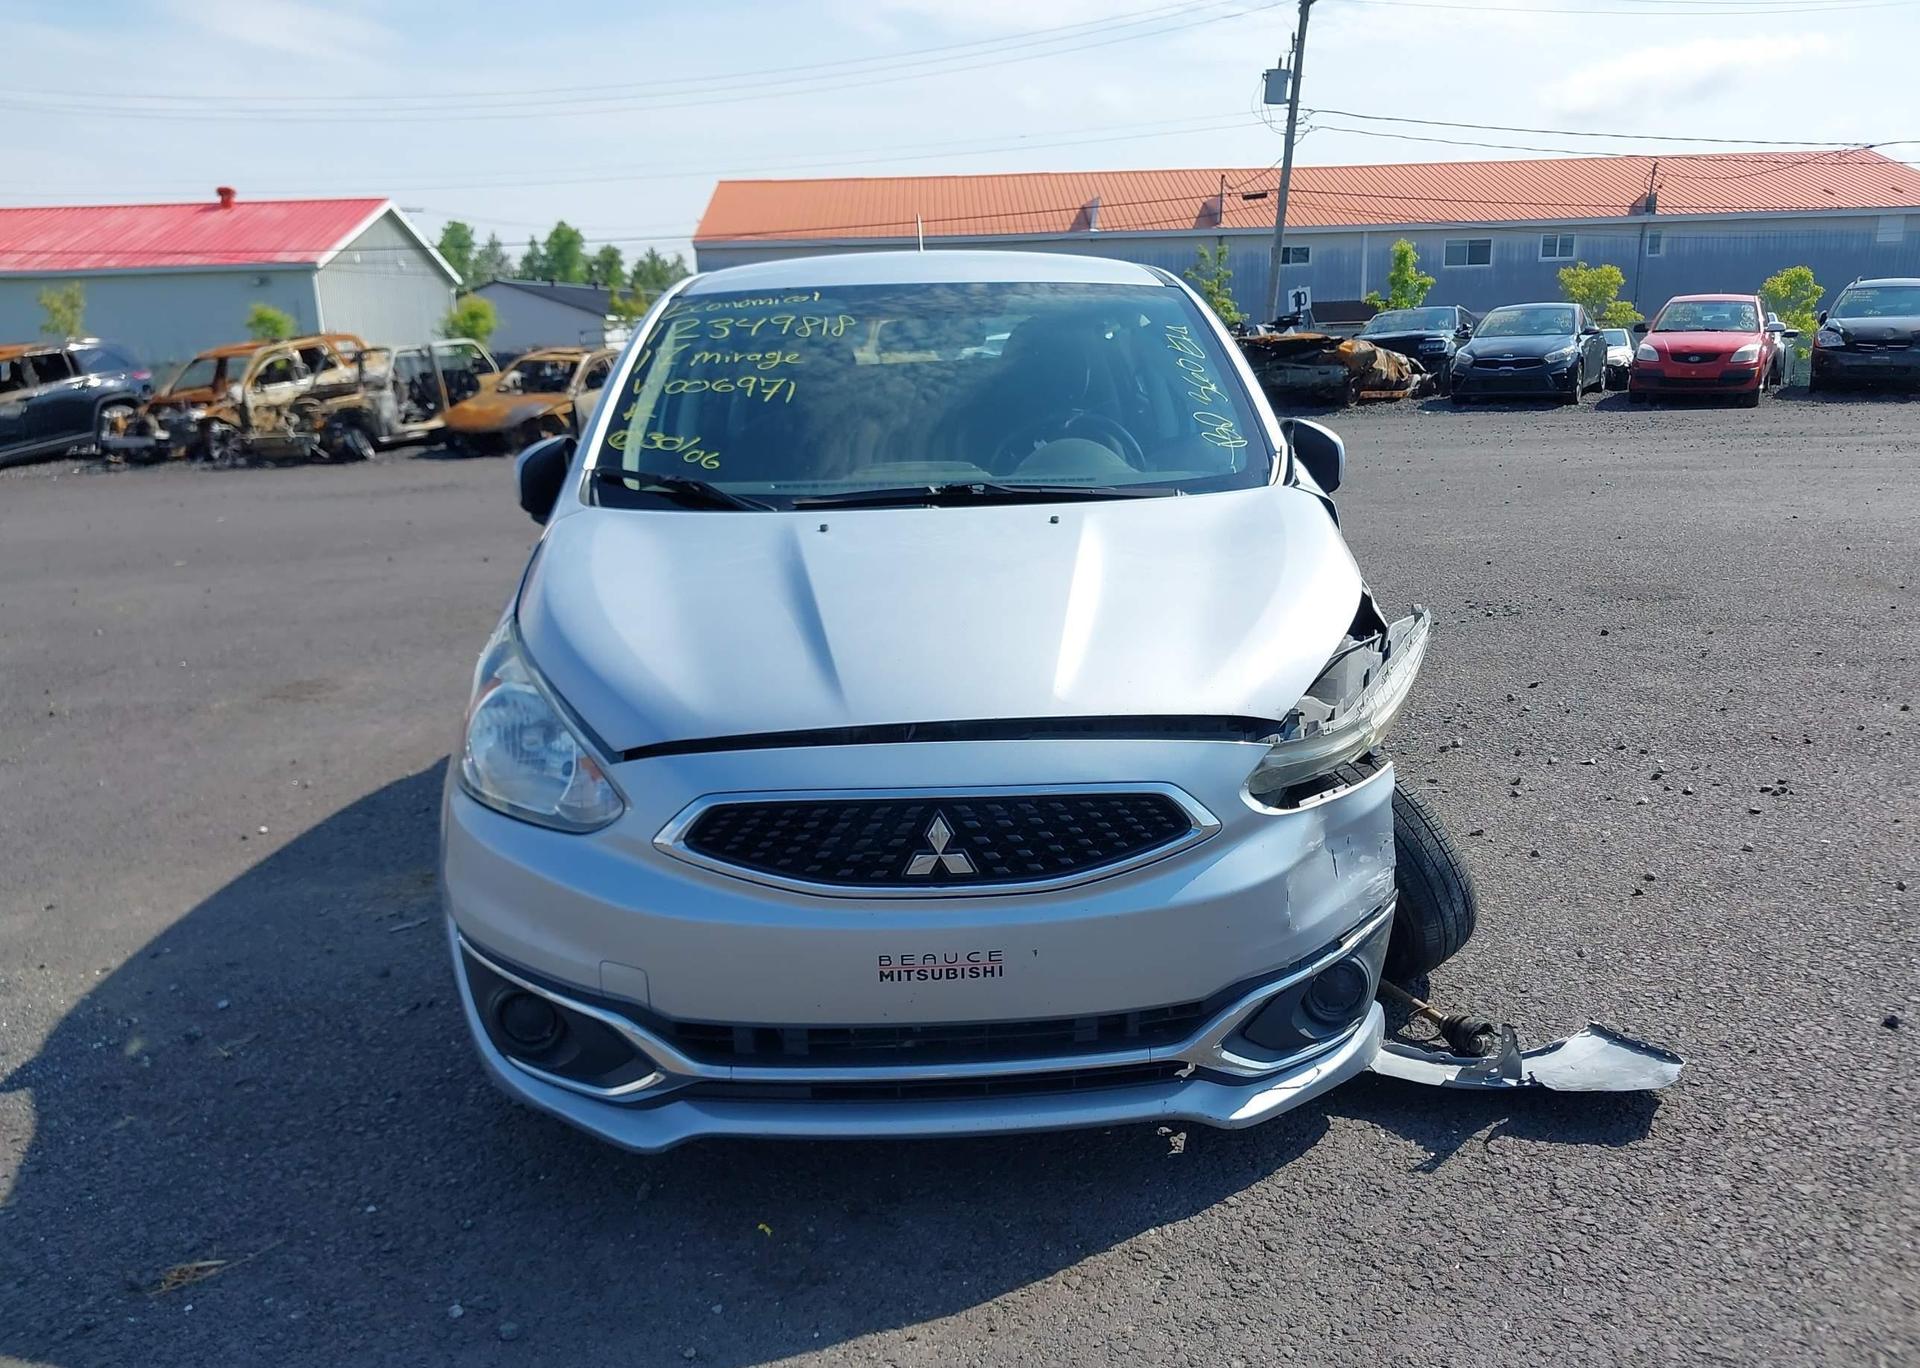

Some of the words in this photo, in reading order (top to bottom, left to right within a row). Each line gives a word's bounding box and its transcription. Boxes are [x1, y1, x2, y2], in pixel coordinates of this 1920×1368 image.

[690, 351, 805, 370] mirage
[878, 950, 1003, 967] BEAUCE
[879, 965, 1003, 982] MITSUBISHI
